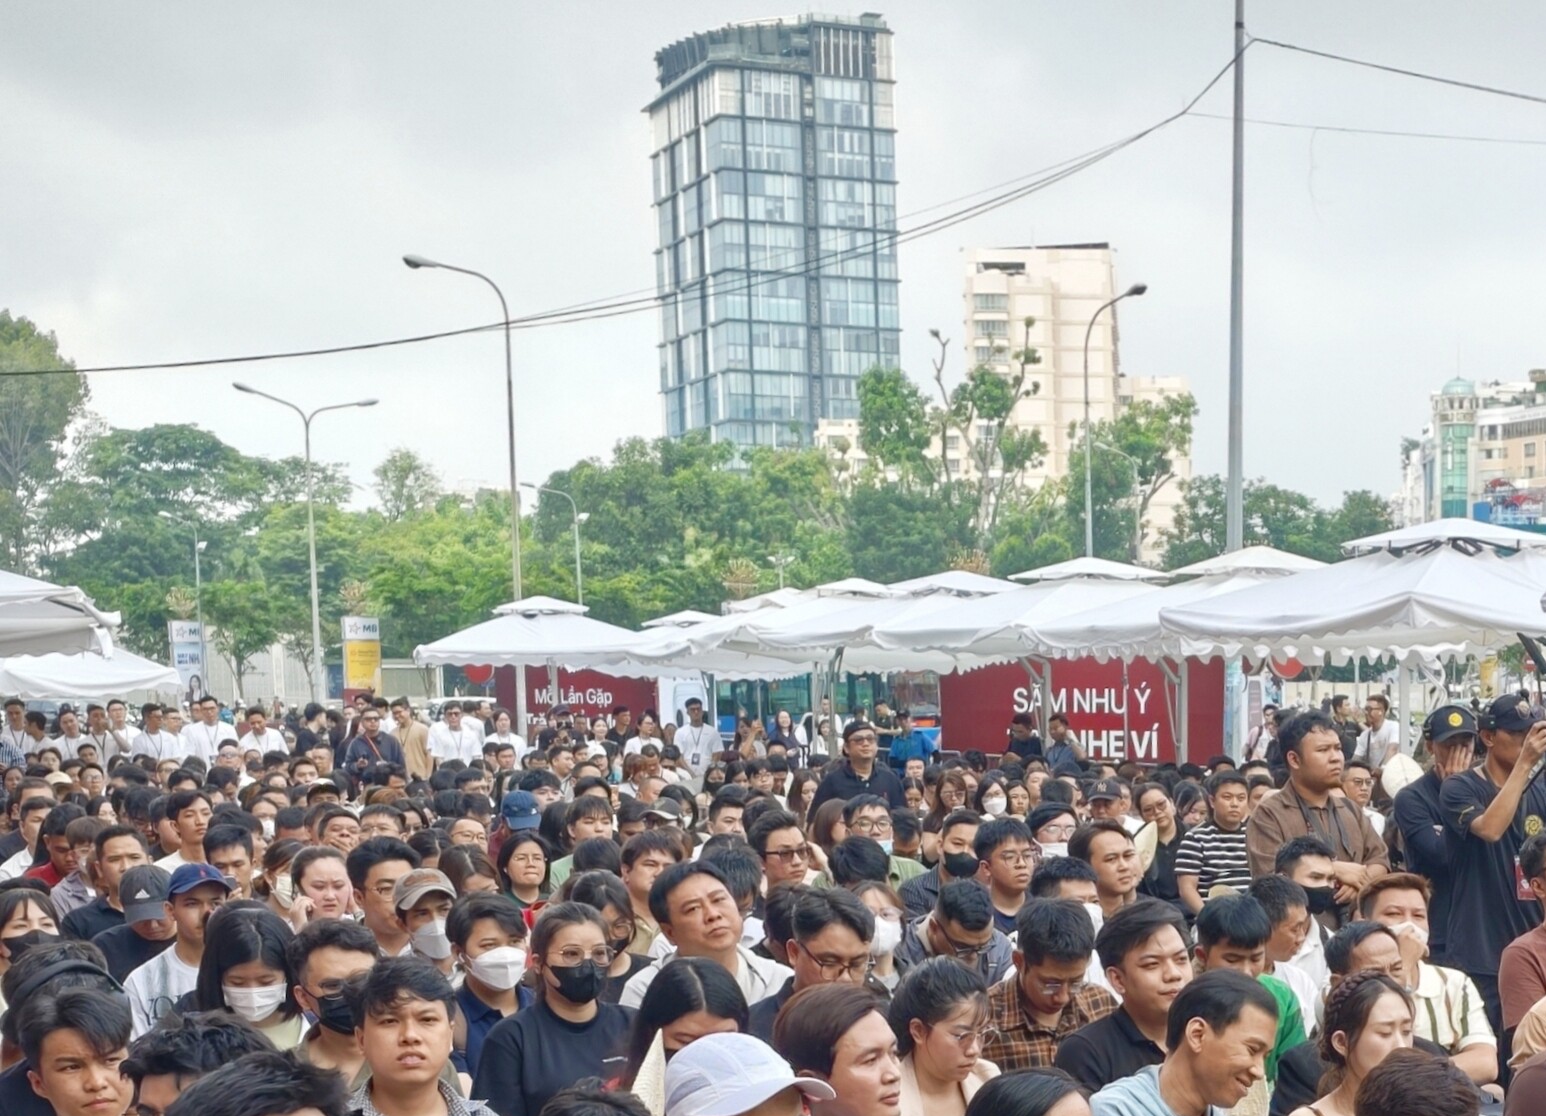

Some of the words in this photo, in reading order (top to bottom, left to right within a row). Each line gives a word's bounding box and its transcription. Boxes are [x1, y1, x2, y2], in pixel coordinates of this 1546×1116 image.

[362, 623, 378, 633] MB
[586, 688, 613, 708] Gặp
[1134, 682, 1151, 714] Ý
[1131, 722, 1160, 759] VÍ
